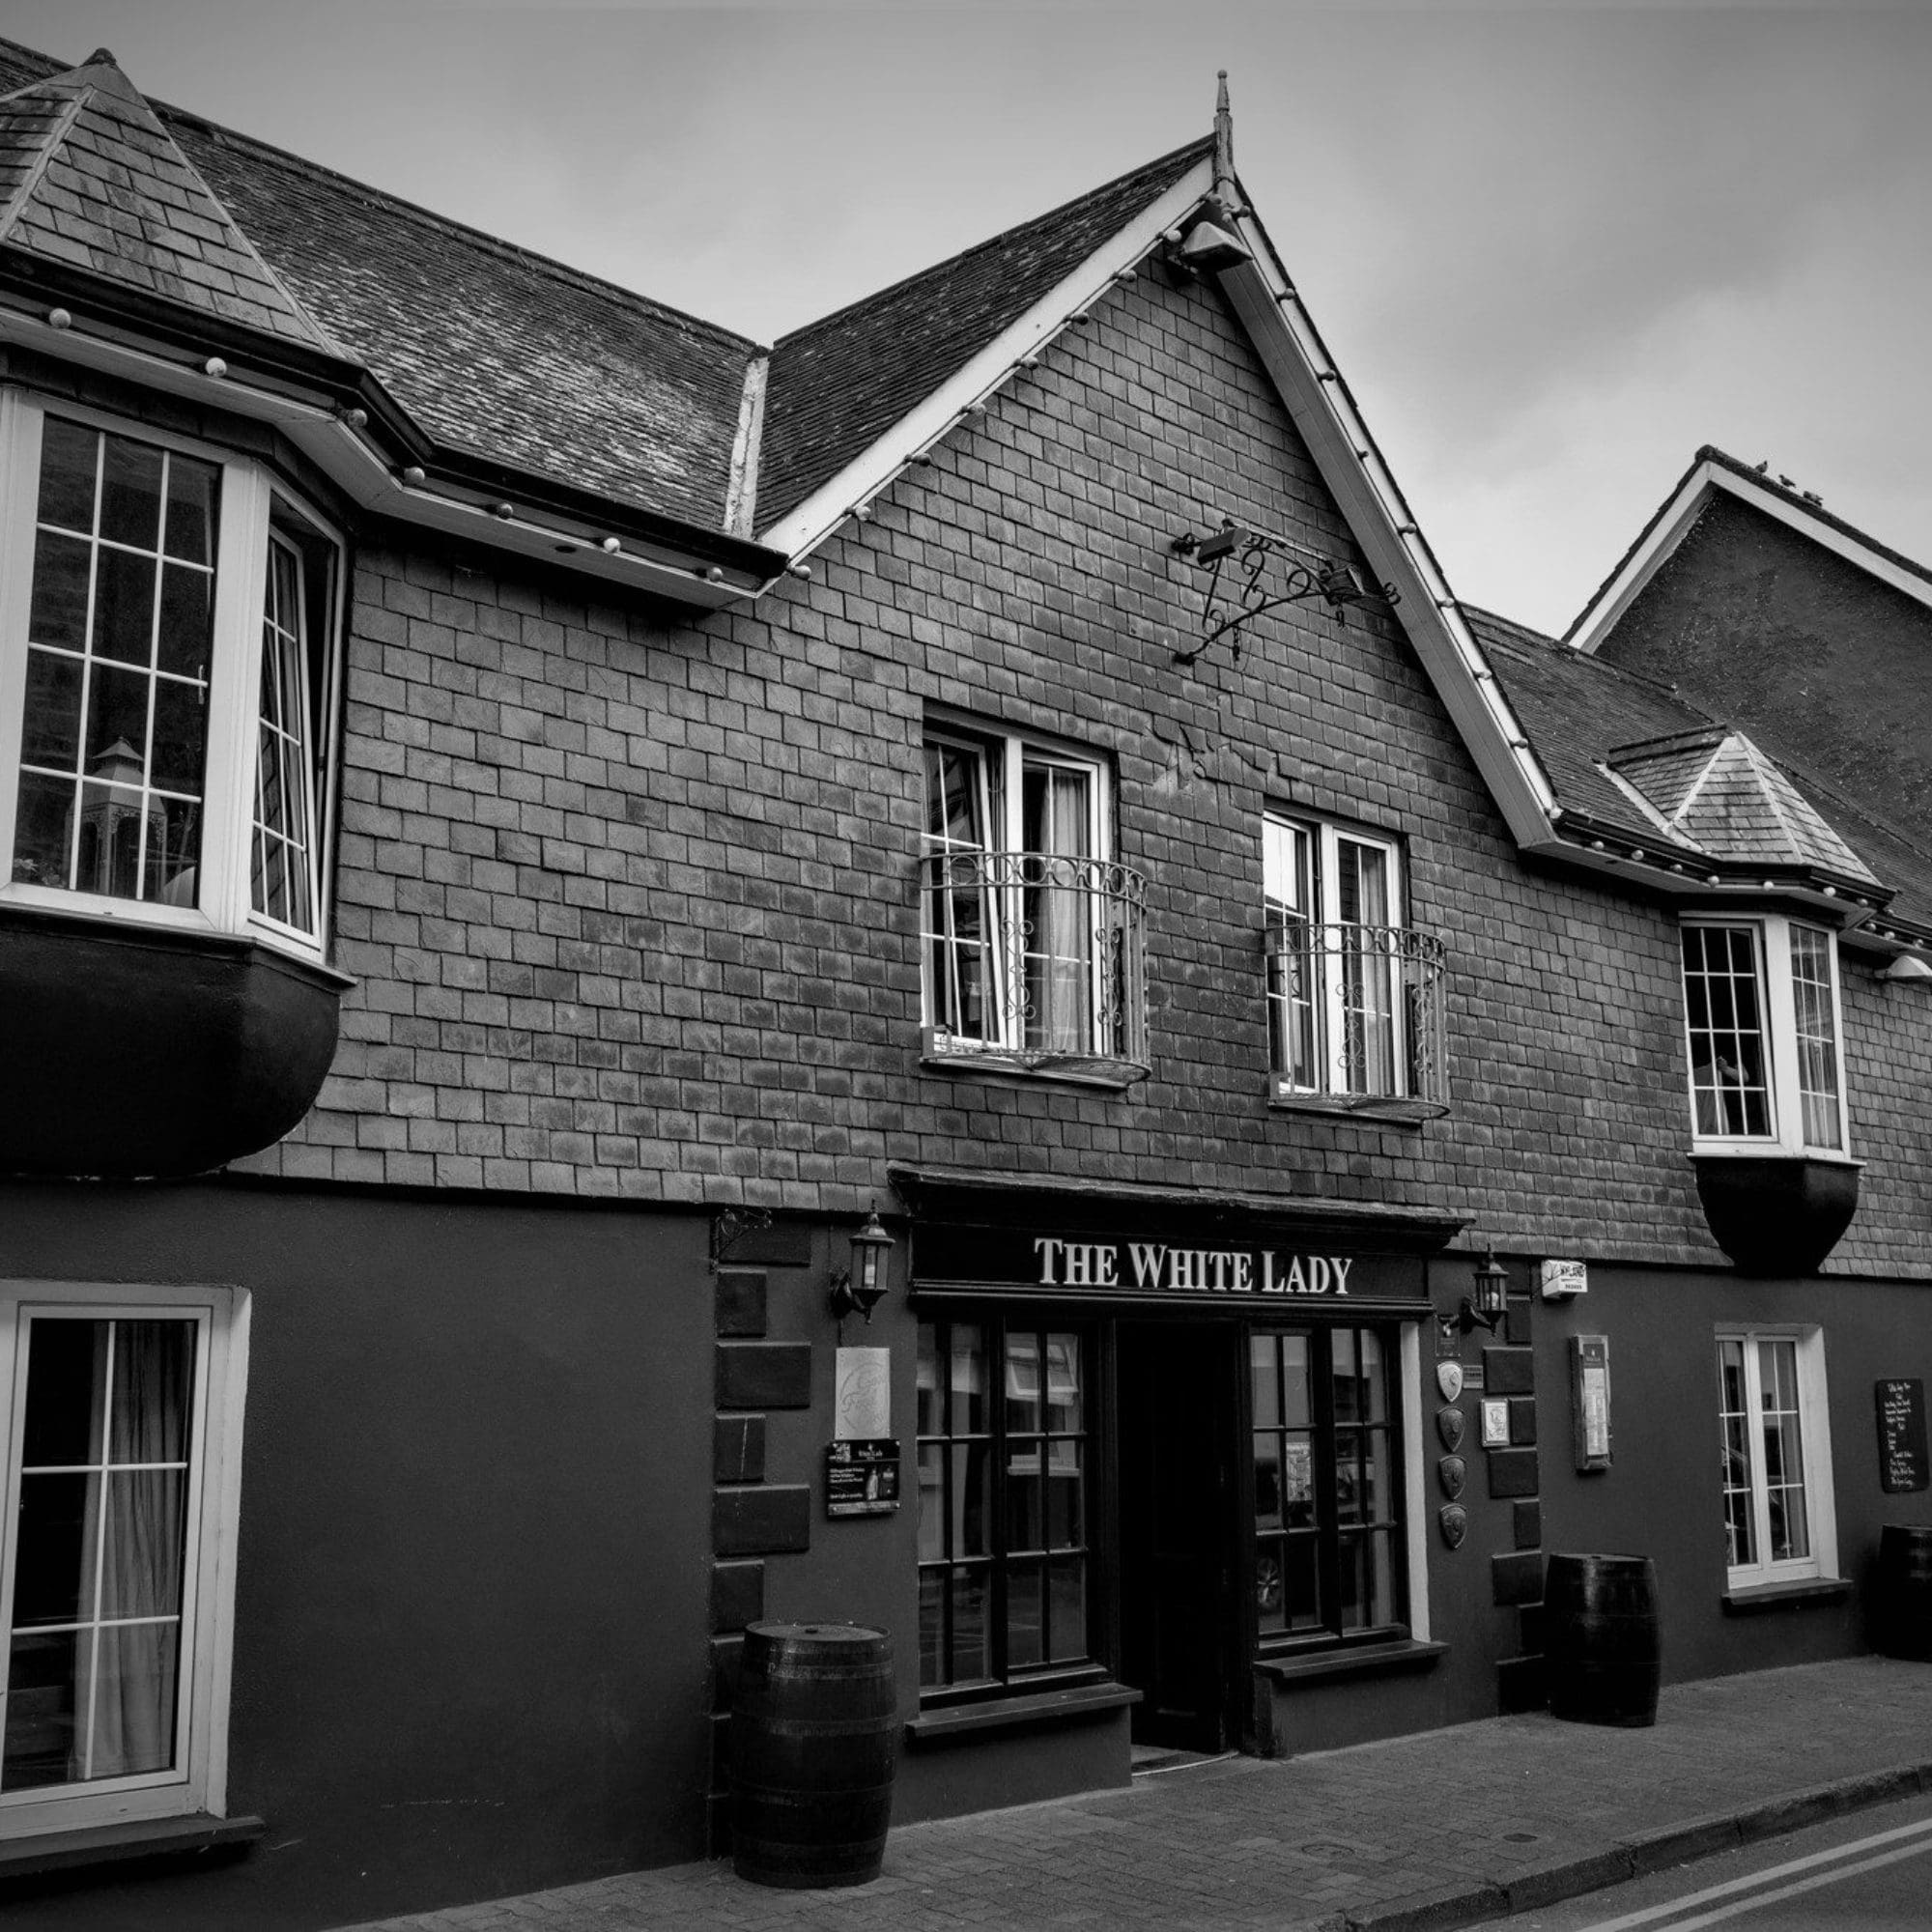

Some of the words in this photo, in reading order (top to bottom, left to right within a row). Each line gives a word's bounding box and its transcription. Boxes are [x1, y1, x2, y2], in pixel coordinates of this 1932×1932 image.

[1035, 1237, 1120, 1287] THE
[1128, 1243, 1254, 1293] WHITE
[1262, 1251, 1353, 1294] LADY
